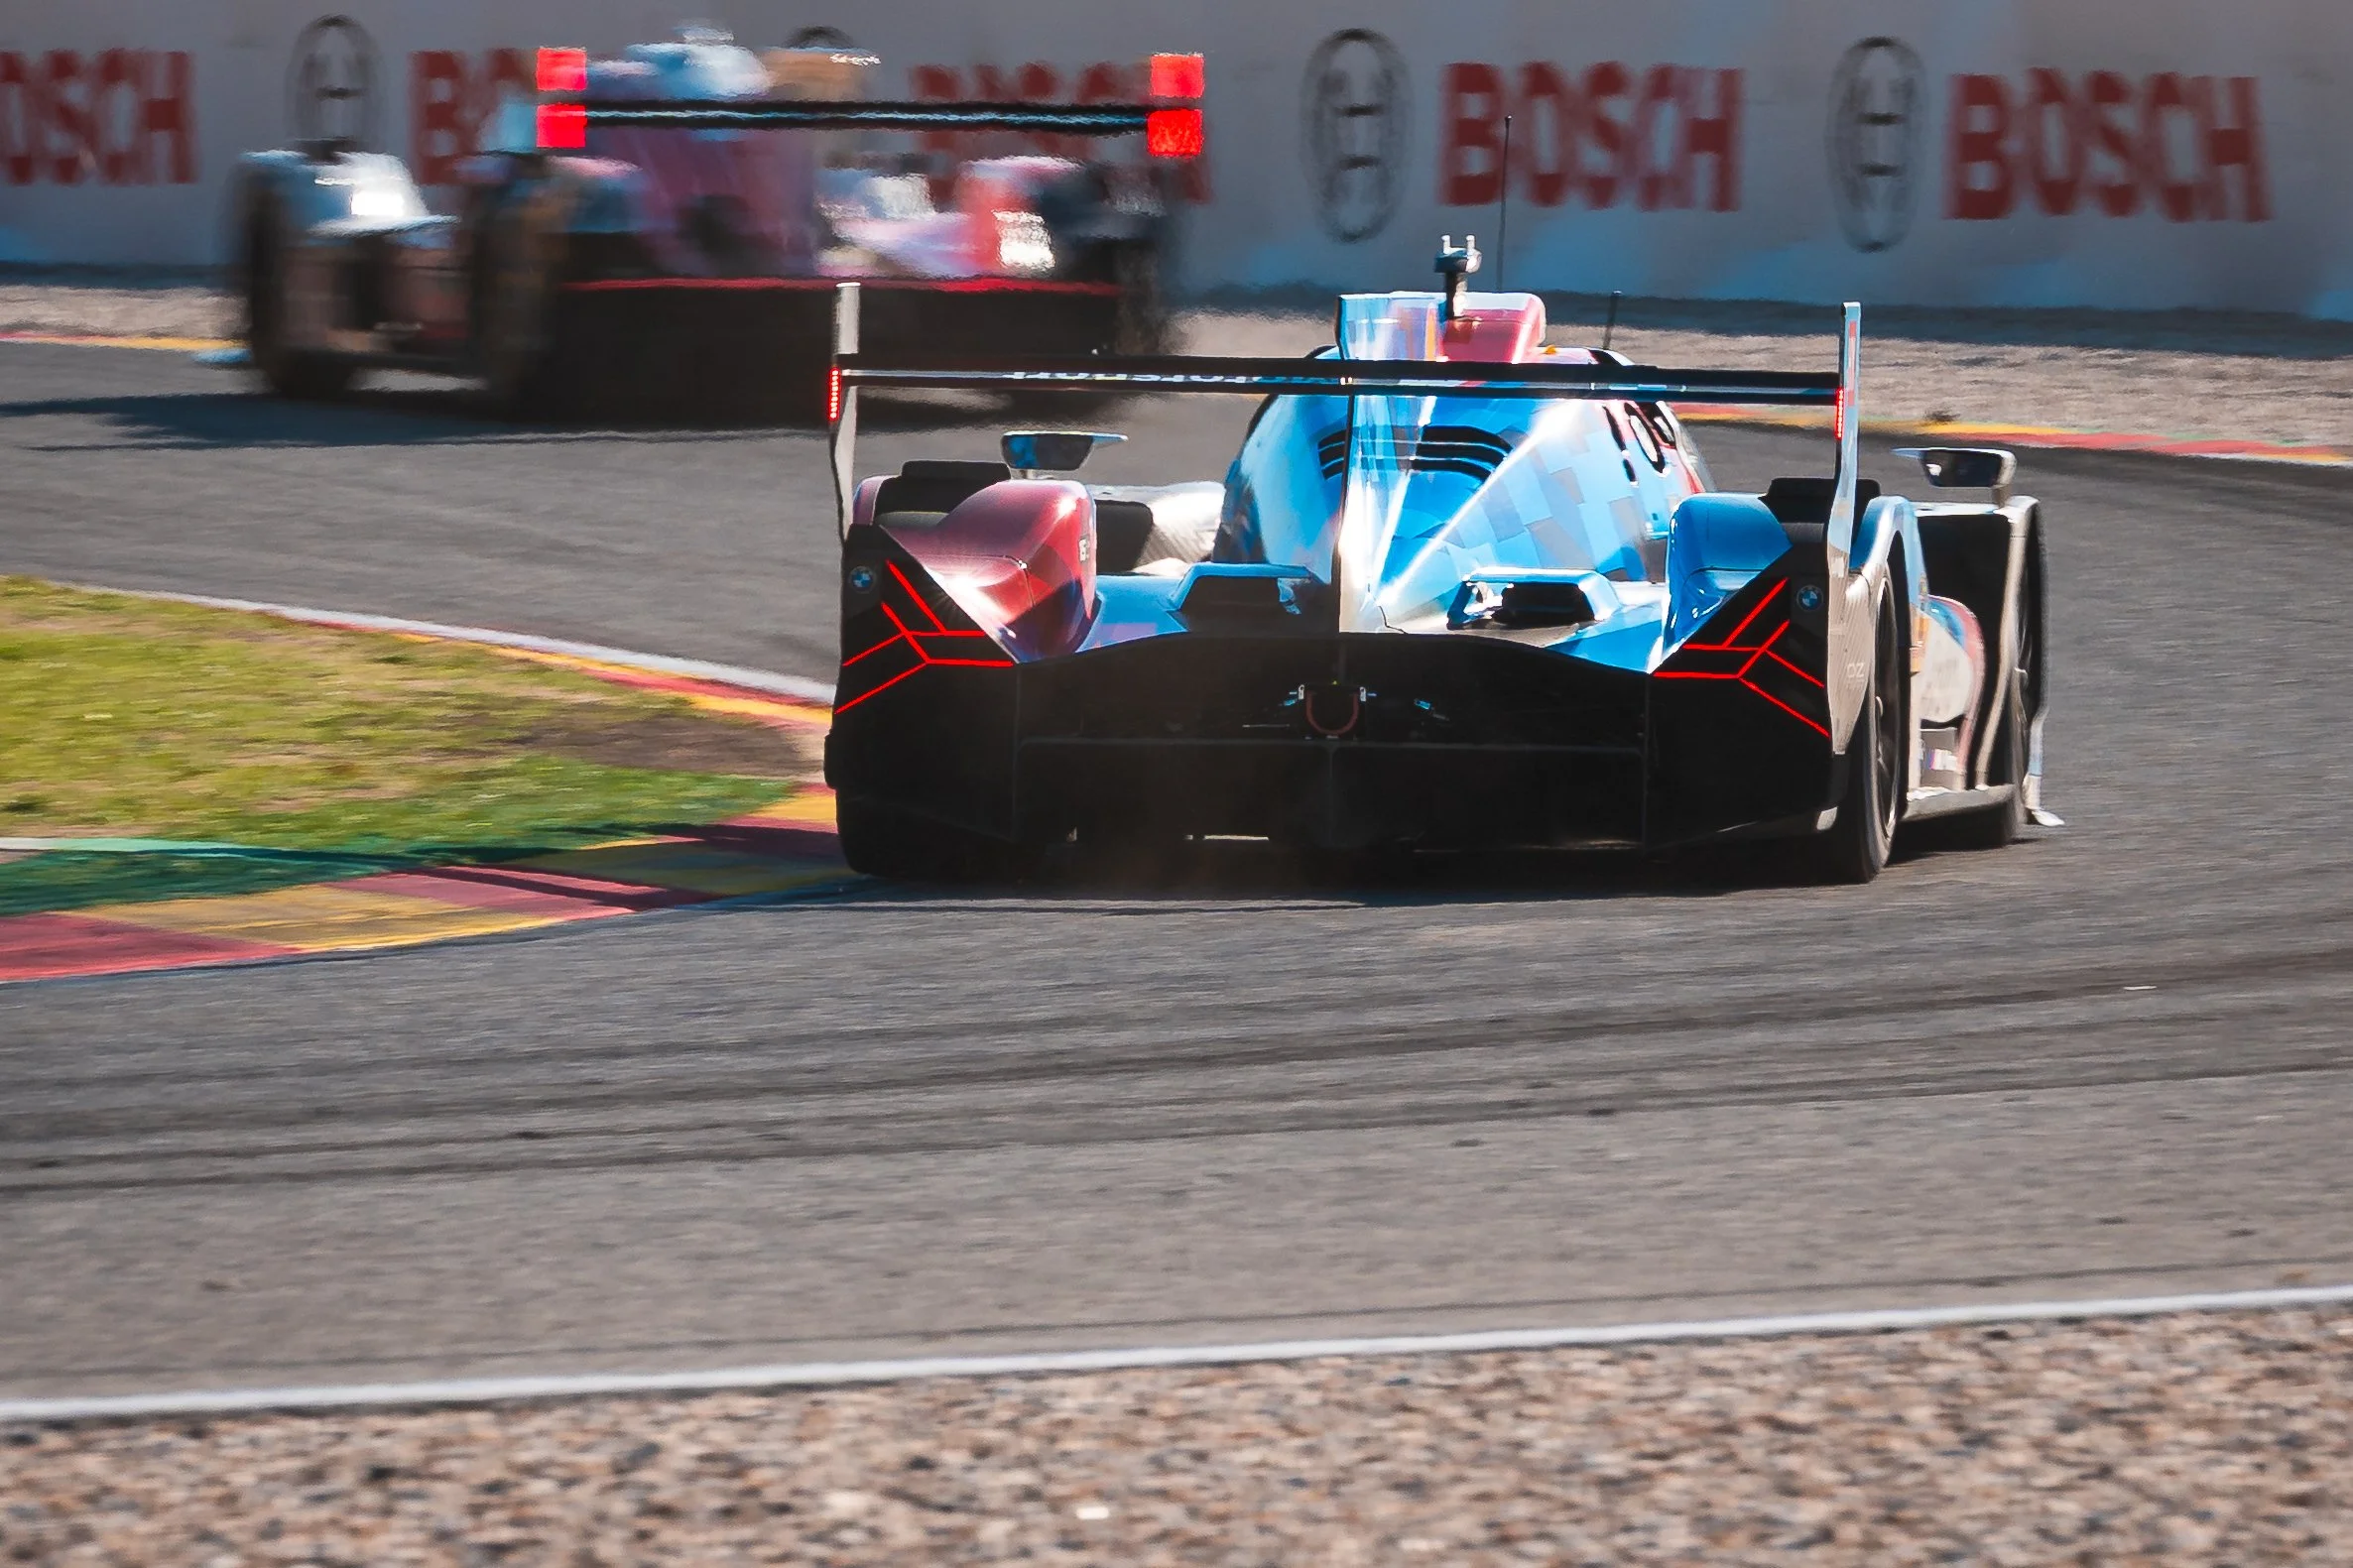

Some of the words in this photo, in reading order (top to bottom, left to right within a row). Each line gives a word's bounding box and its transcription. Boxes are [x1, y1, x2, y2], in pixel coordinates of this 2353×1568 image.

[0, 50, 194, 185] OSCH
[1440, 62, 1742, 211] BOSCH
[1945, 69, 2273, 221] BOSCH
